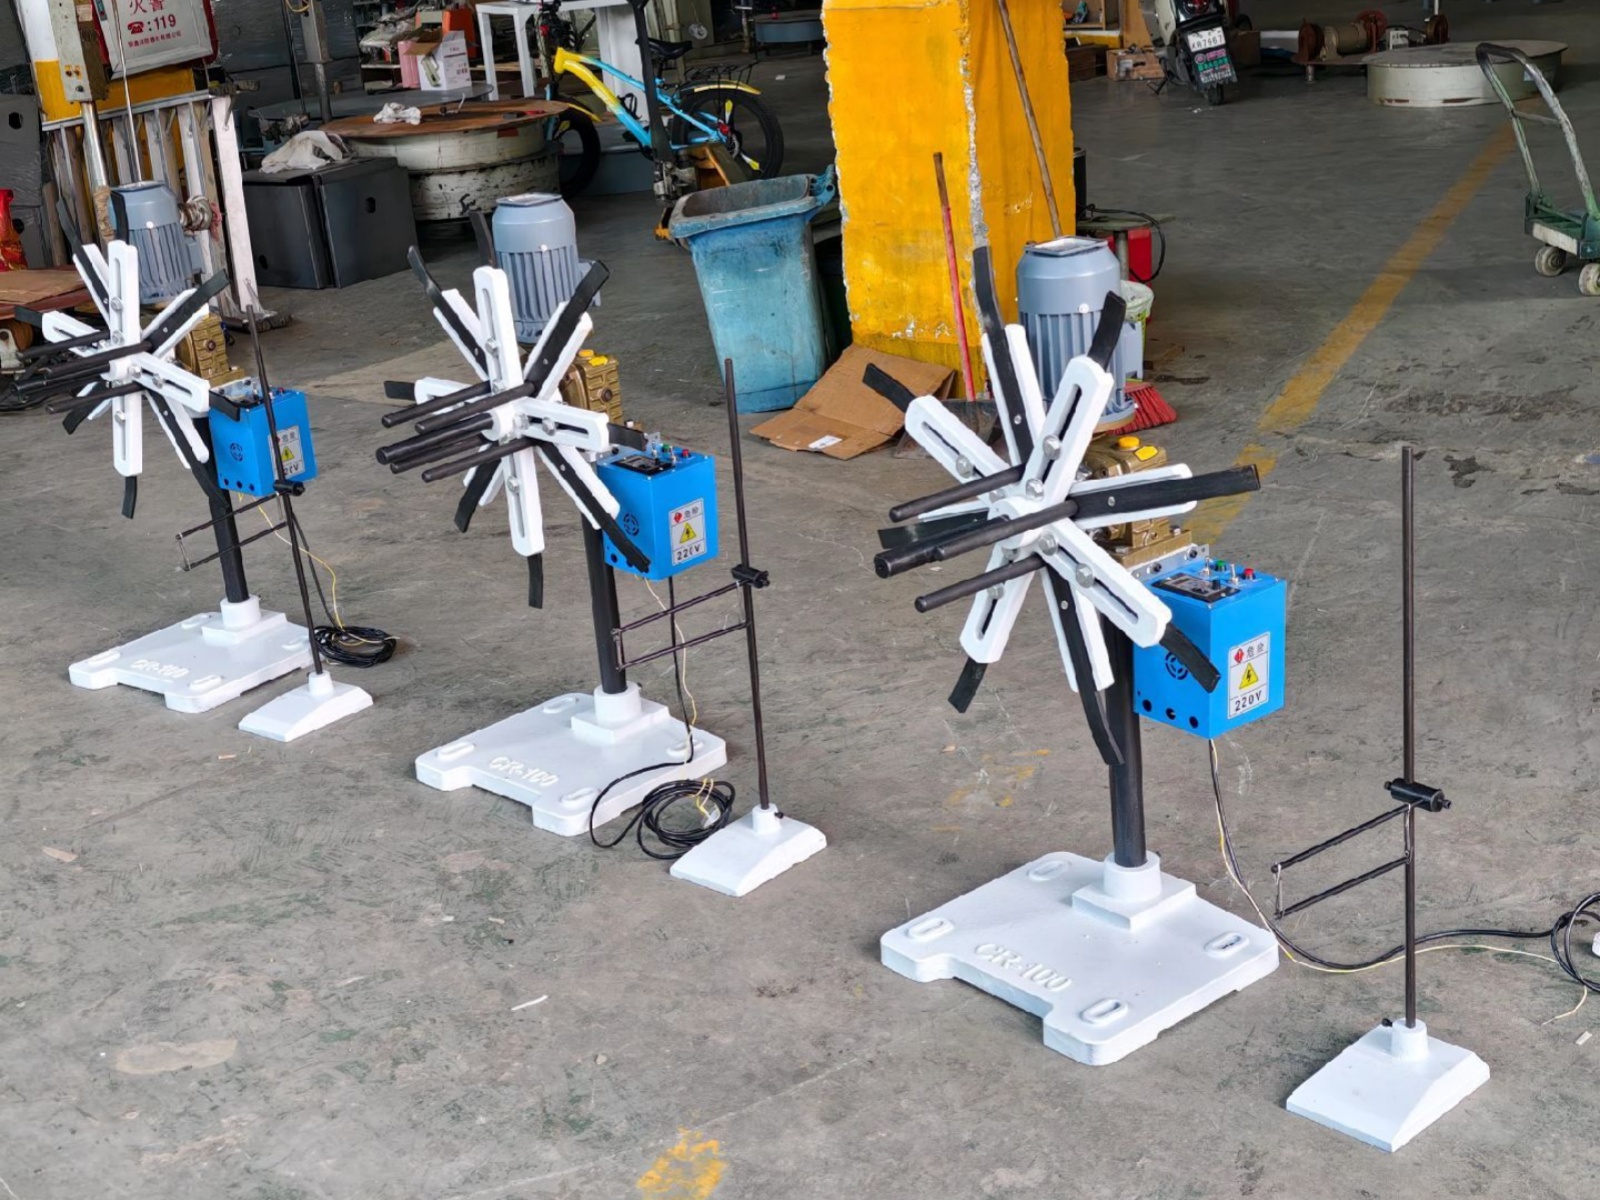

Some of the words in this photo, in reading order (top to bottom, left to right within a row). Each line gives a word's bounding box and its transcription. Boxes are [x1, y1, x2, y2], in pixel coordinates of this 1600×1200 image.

[1246, 642, 1264, 659] 危险
[1234, 691, 1262, 712] 220V
[974, 943, 1073, 993] CR-100
